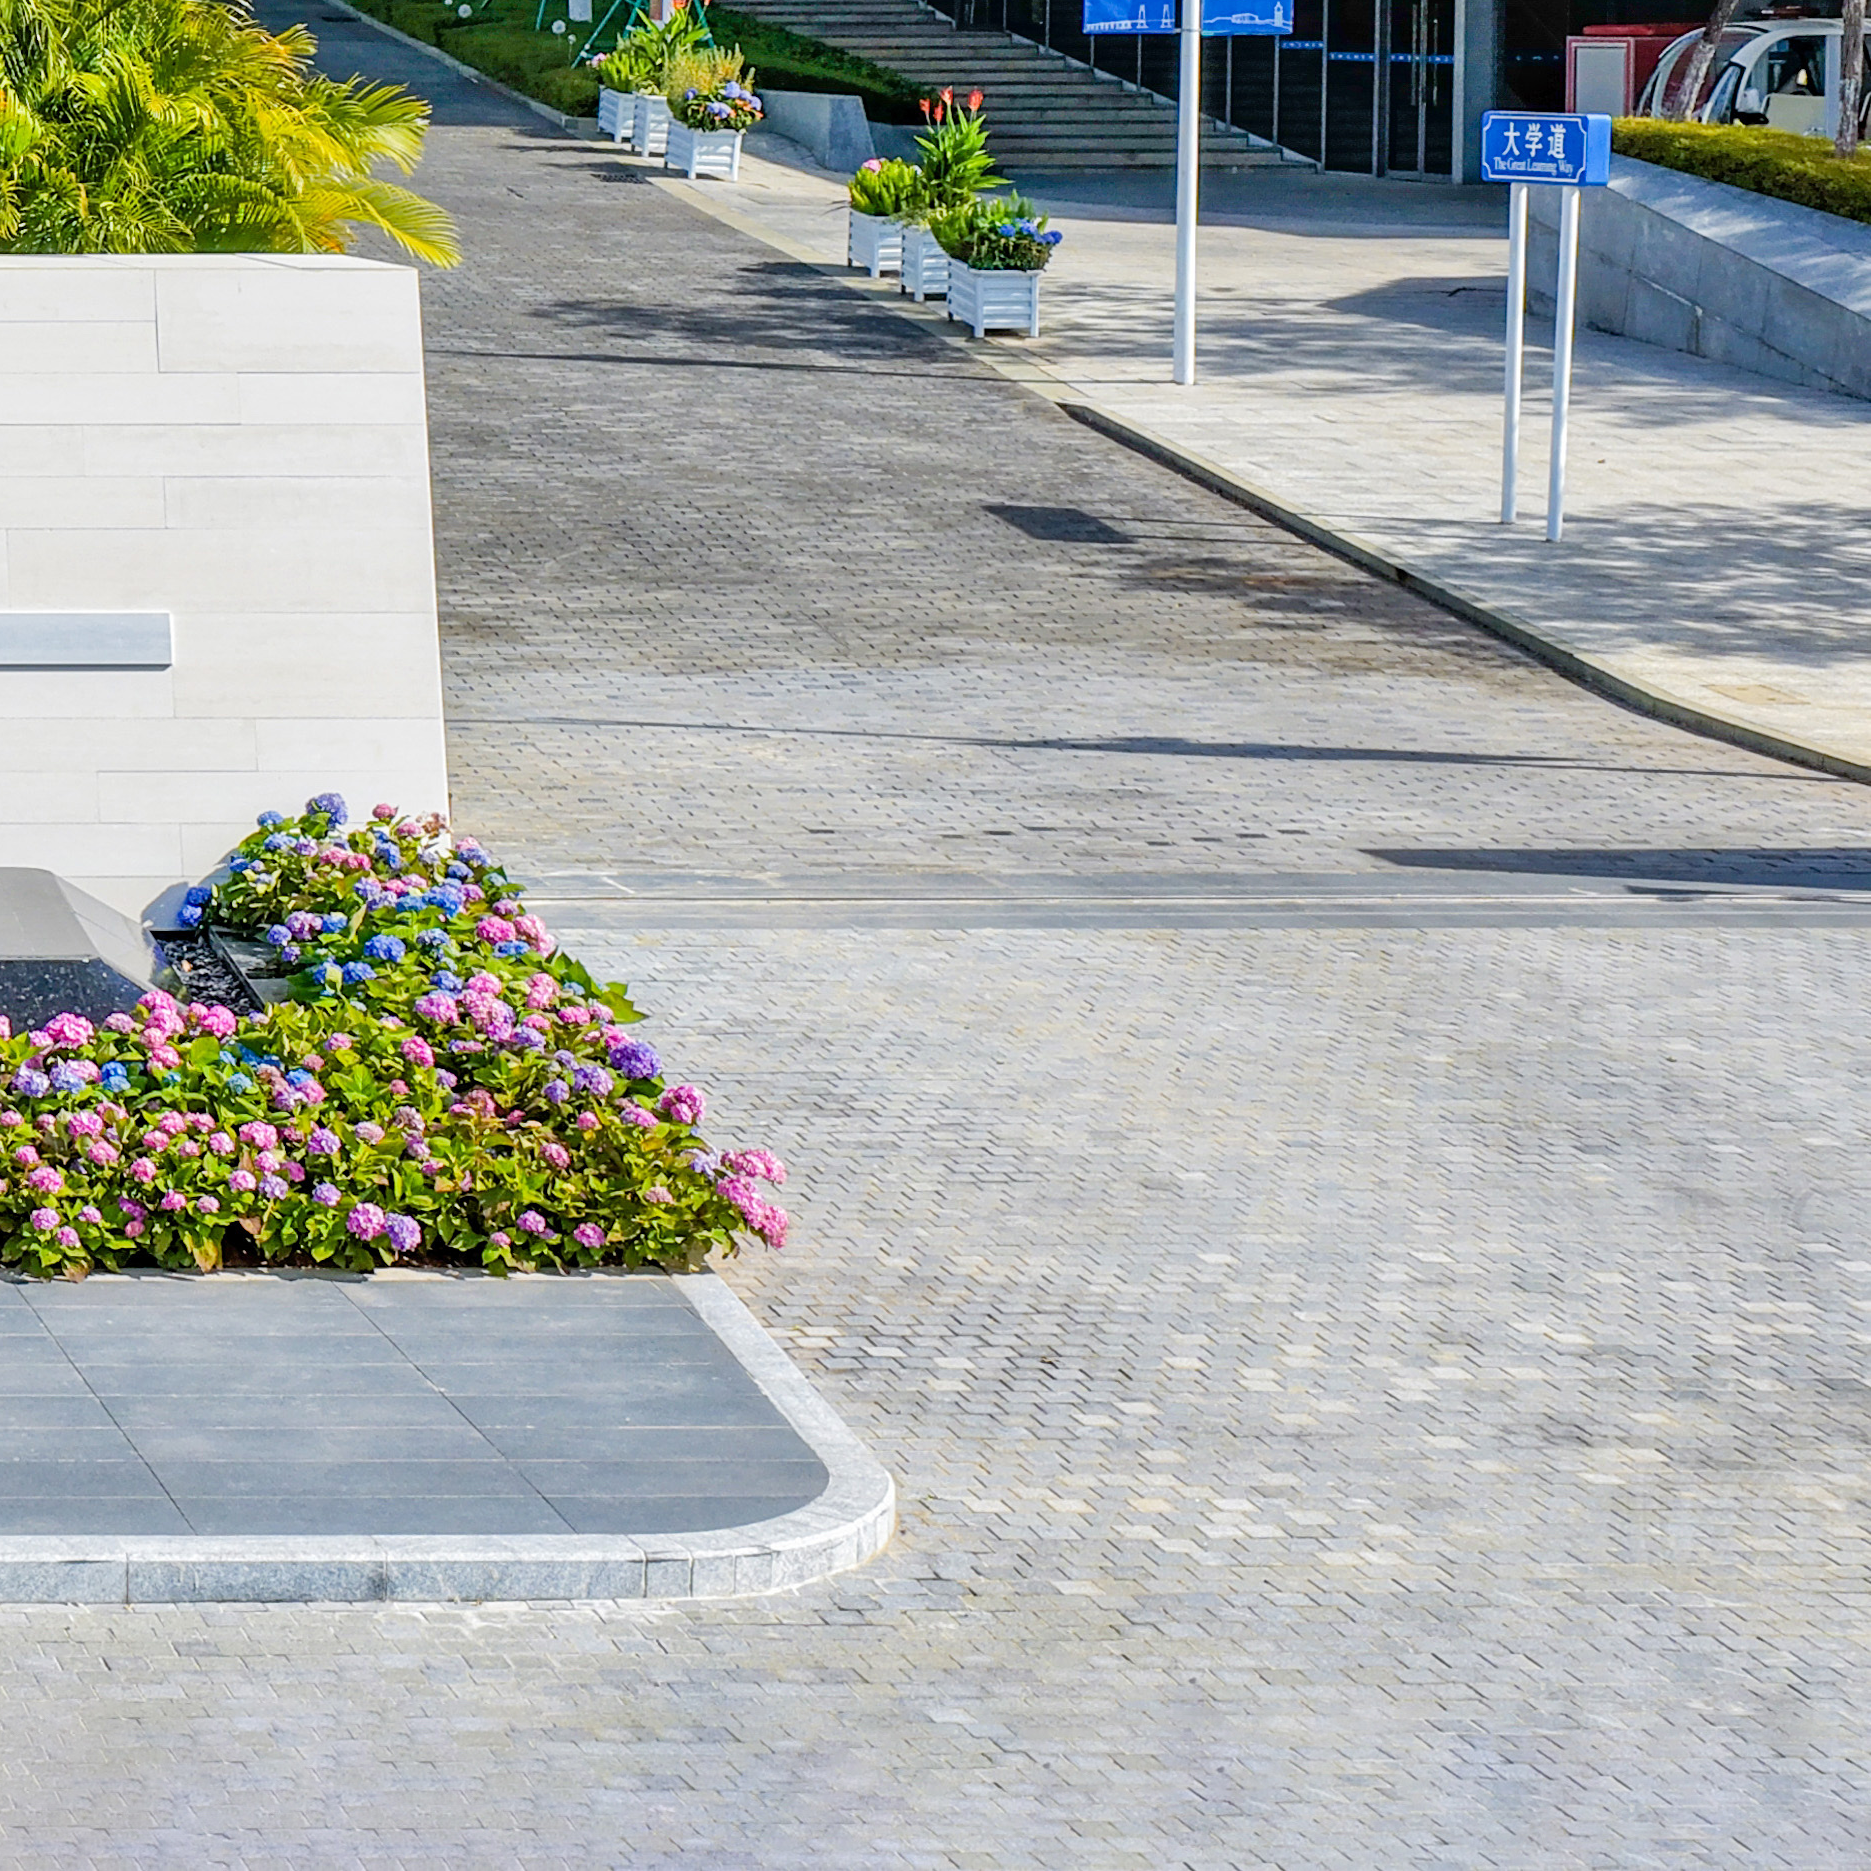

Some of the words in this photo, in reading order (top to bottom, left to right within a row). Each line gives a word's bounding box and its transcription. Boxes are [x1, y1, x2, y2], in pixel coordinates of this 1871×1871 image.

[1502, 122, 1566, 159] 大学道
[1493, 156, 1507, 170] The
[1558, 159, 1574, 176] Way
